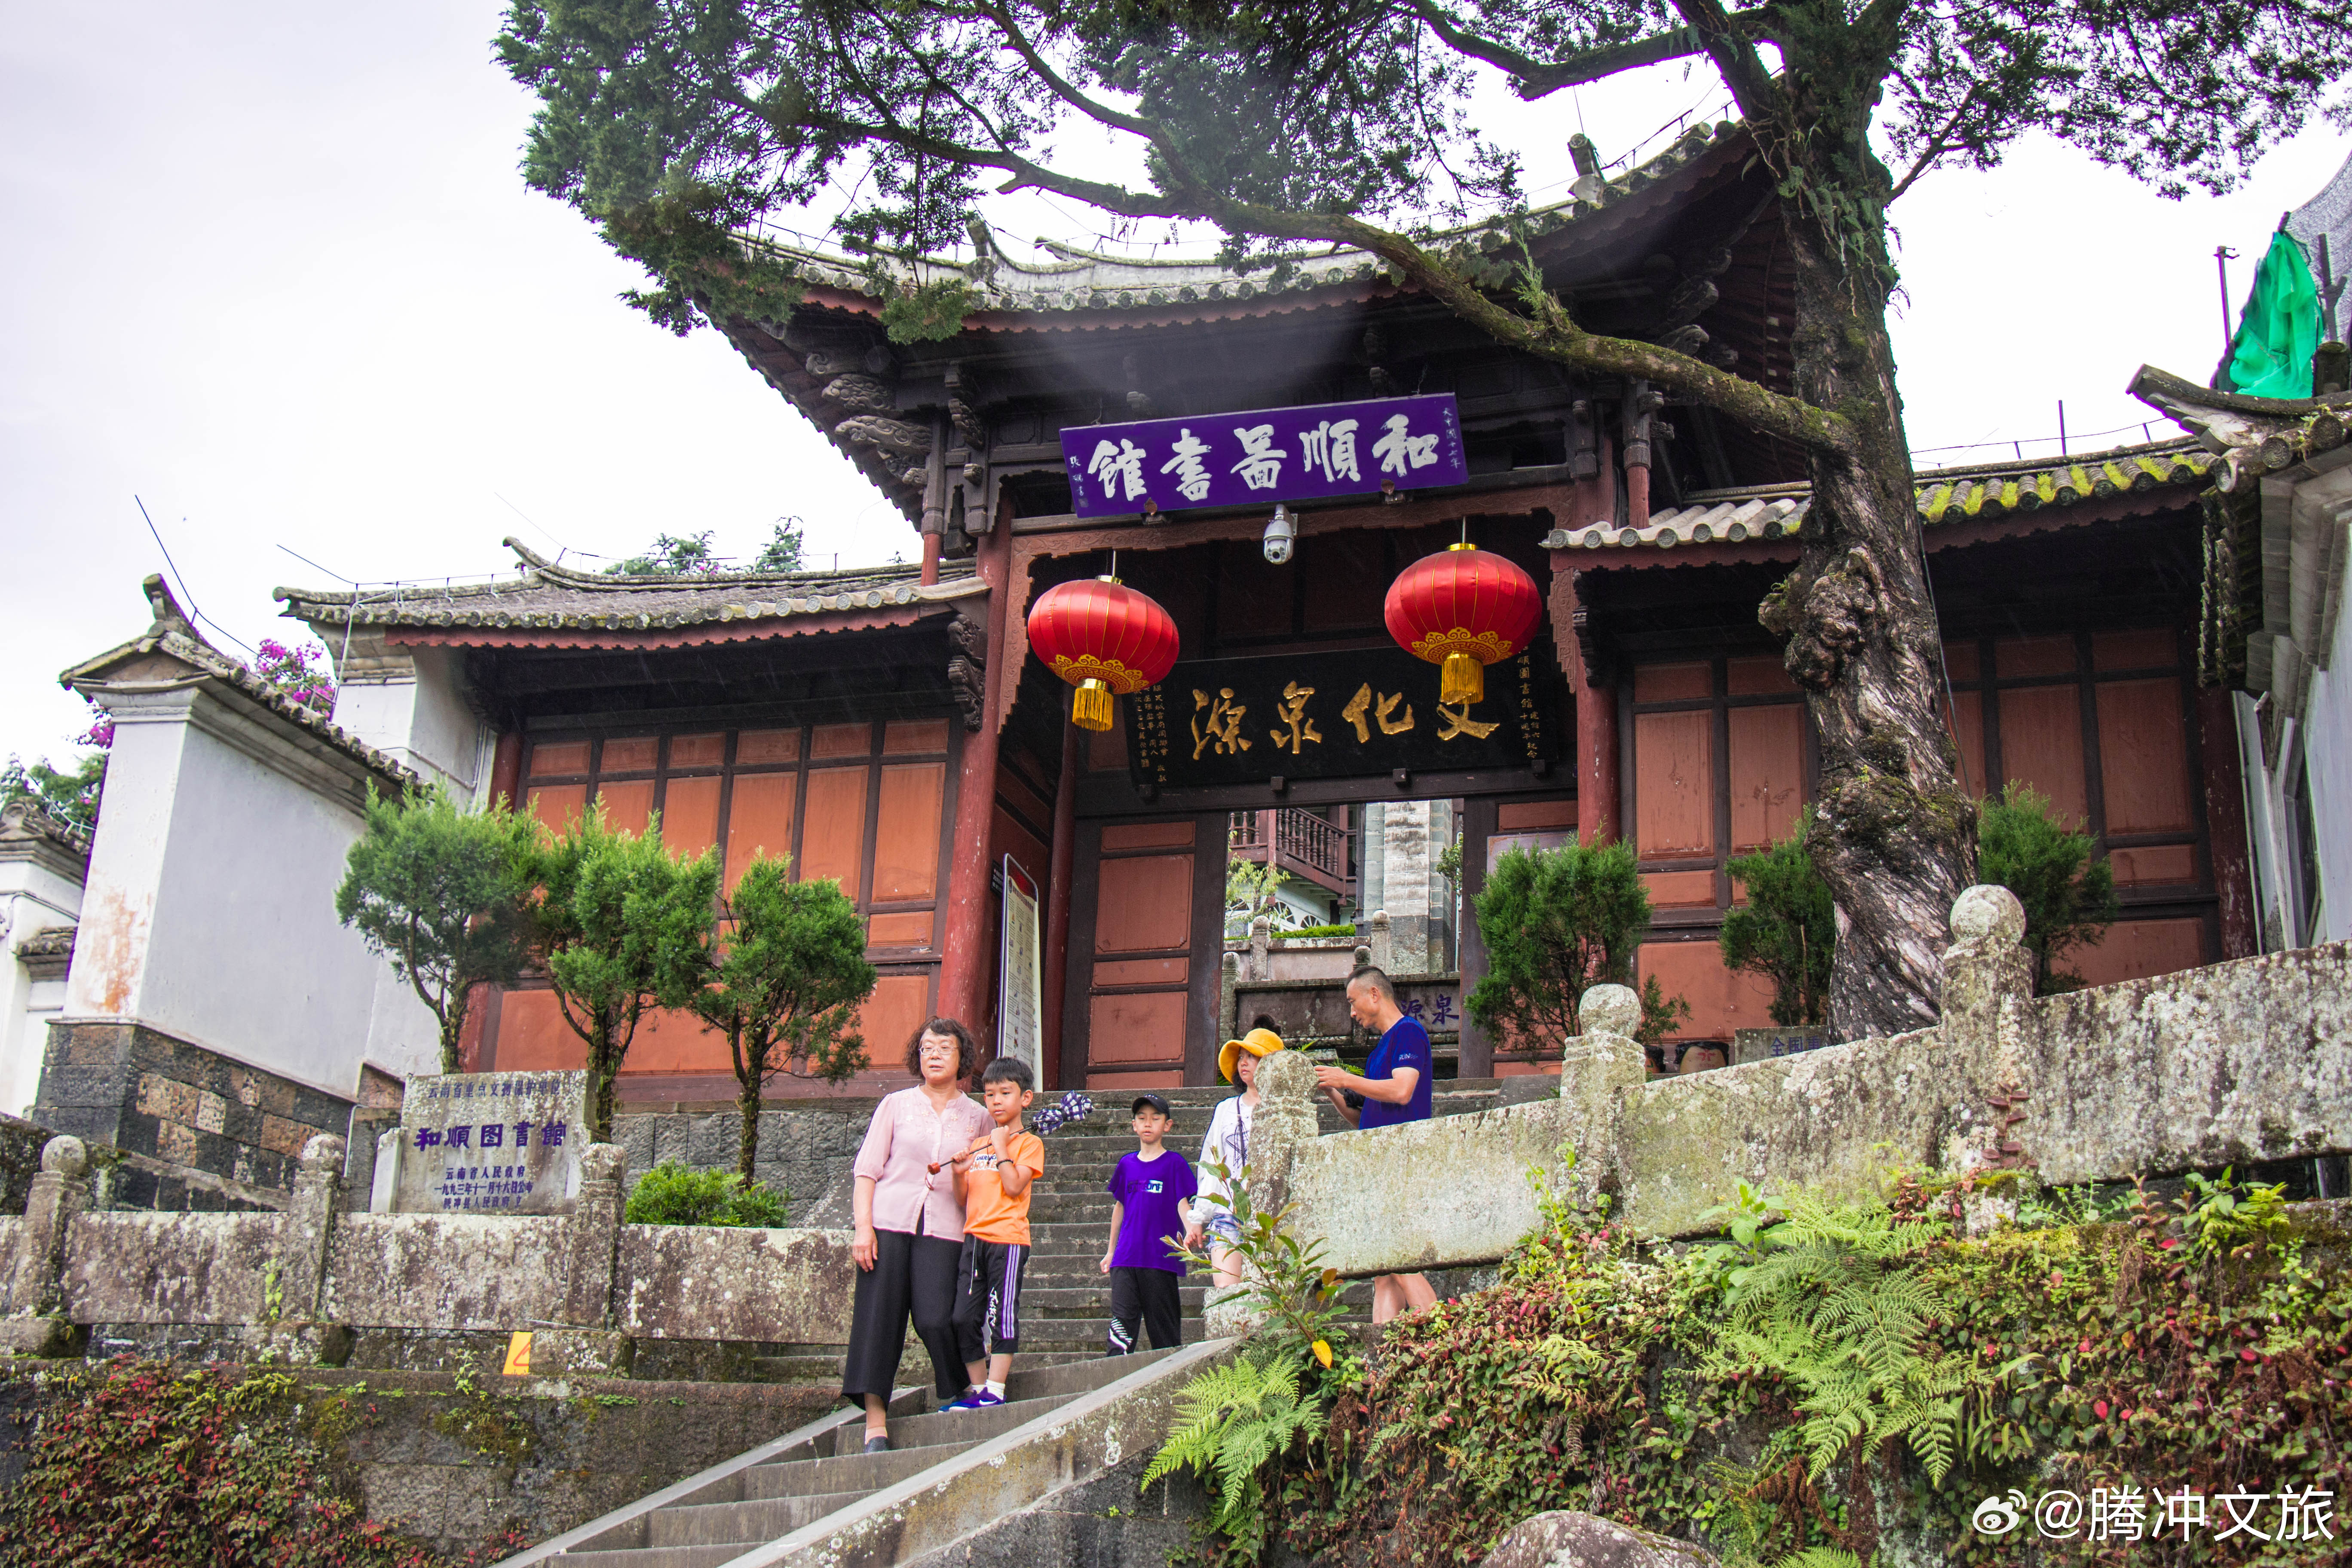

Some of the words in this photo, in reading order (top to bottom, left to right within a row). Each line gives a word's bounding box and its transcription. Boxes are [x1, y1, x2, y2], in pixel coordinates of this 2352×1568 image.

[446, 1165, 525, 1180] 云南省人民政府
[434, 1181, 534, 1195] 一九九三年十一月十六日公布
